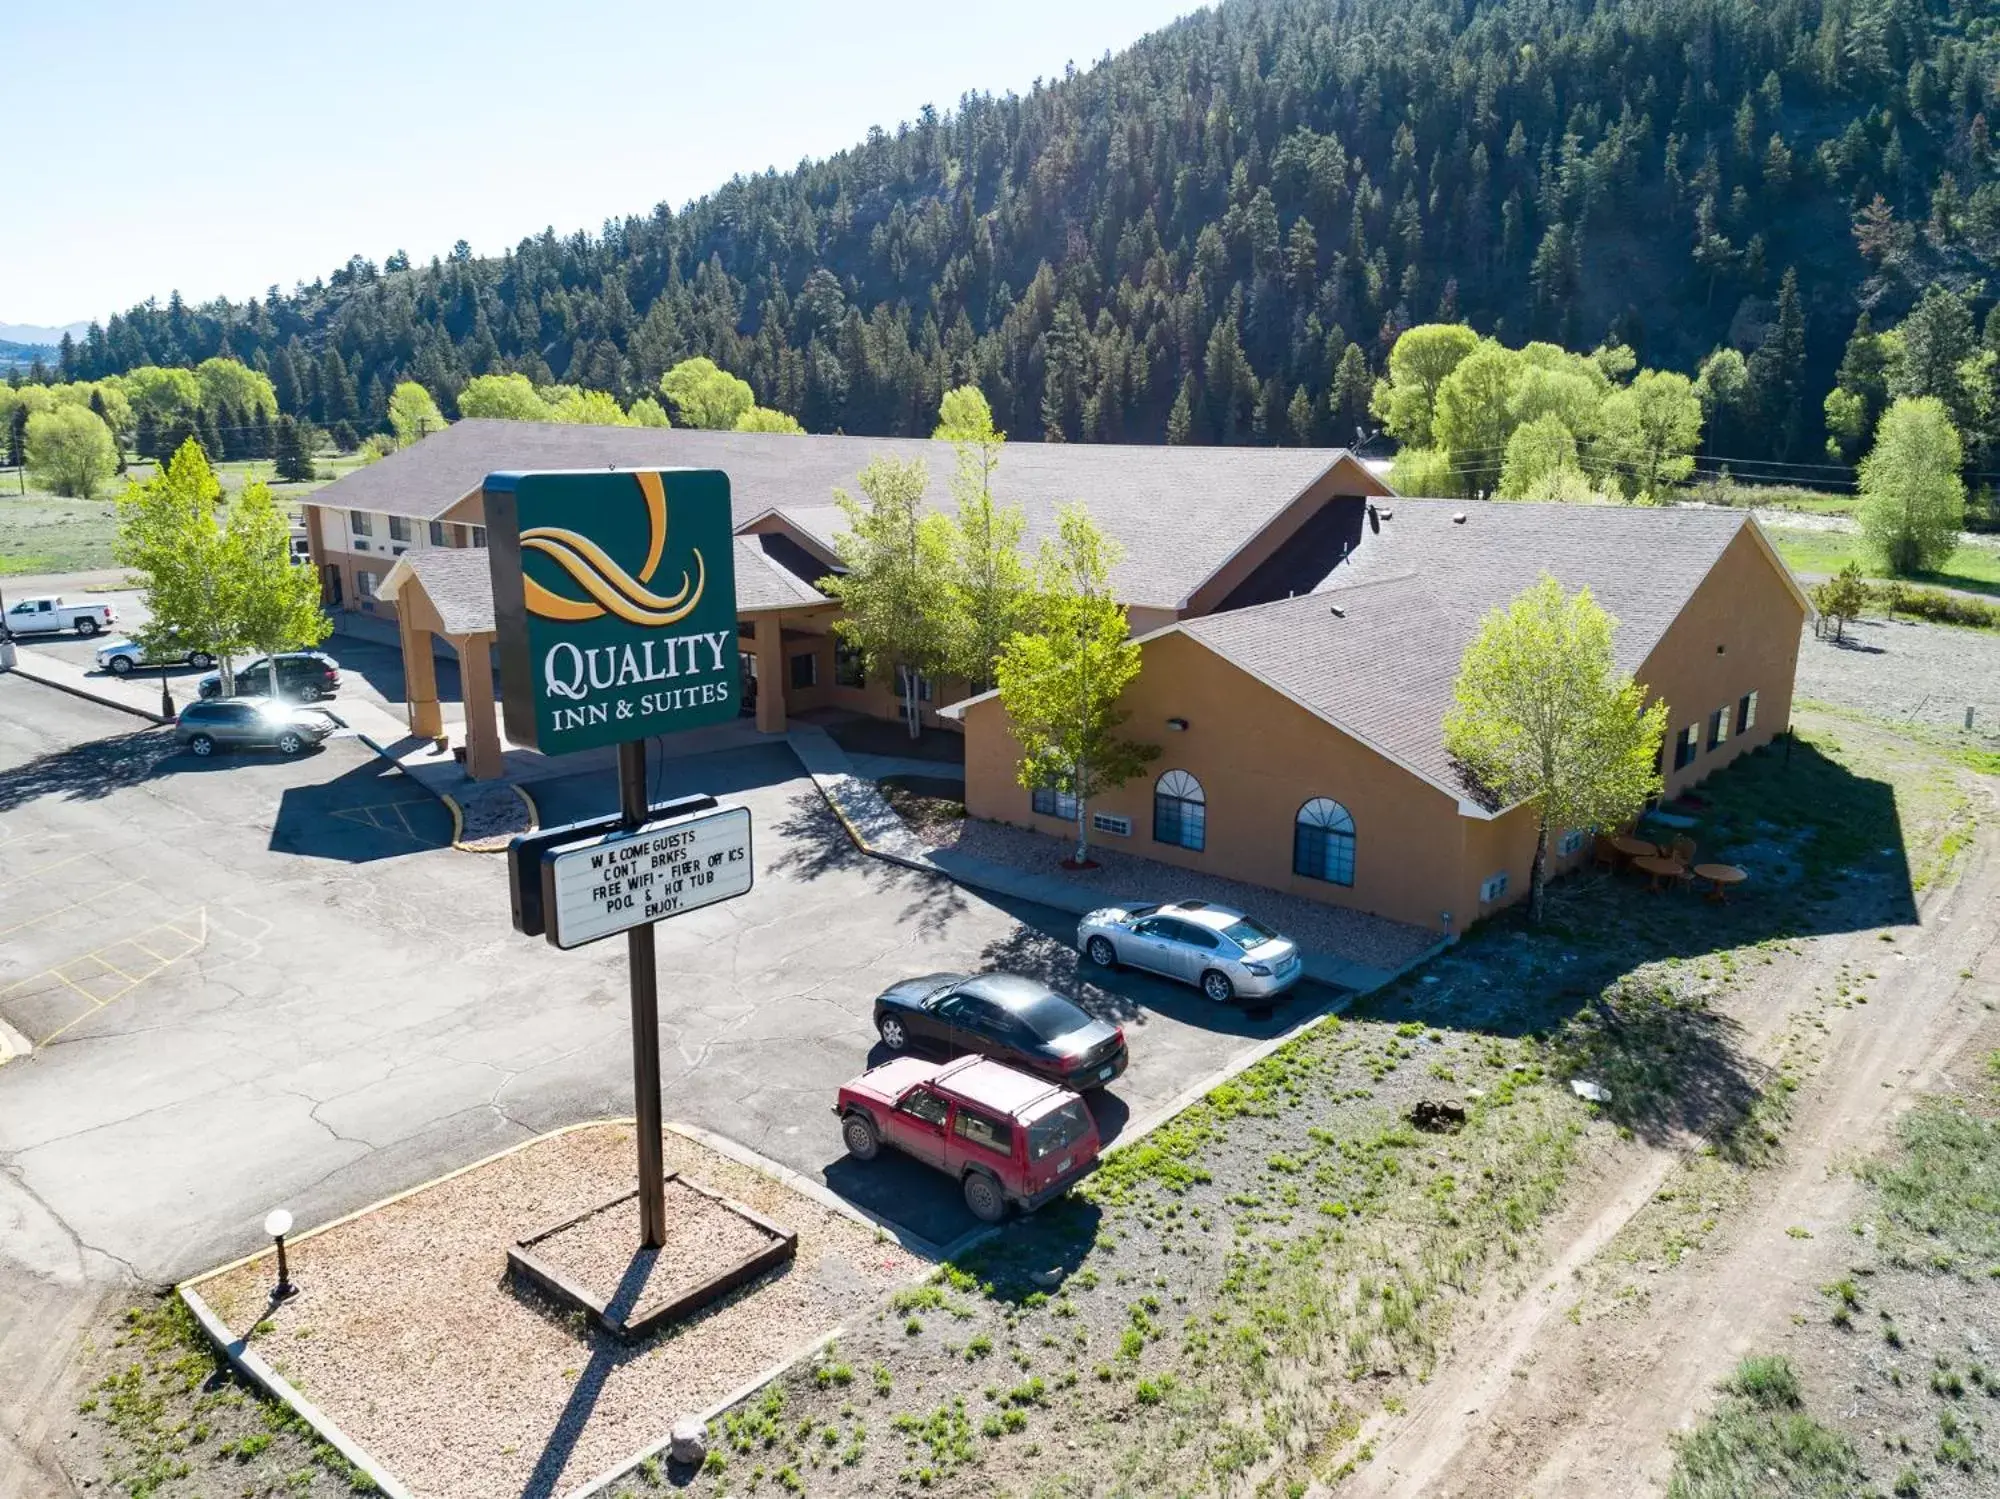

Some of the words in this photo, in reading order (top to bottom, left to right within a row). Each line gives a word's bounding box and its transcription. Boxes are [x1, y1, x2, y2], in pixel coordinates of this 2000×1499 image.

[544, 630, 730, 700] QUALITY
[552, 702, 608, 731] INN
[615, 699, 634, 719] &
[641, 682, 729, 715] SUITES
[651, 847, 687, 869] BRKFS
[652, 830, 696, 852] GUESTS
[592, 881, 621, 901] FREE
[627, 872, 654, 890] WIFI
[671, 859, 701, 878] FIBER
[664, 879, 684, 896] HOT
[689, 870, 714, 887] TUB
